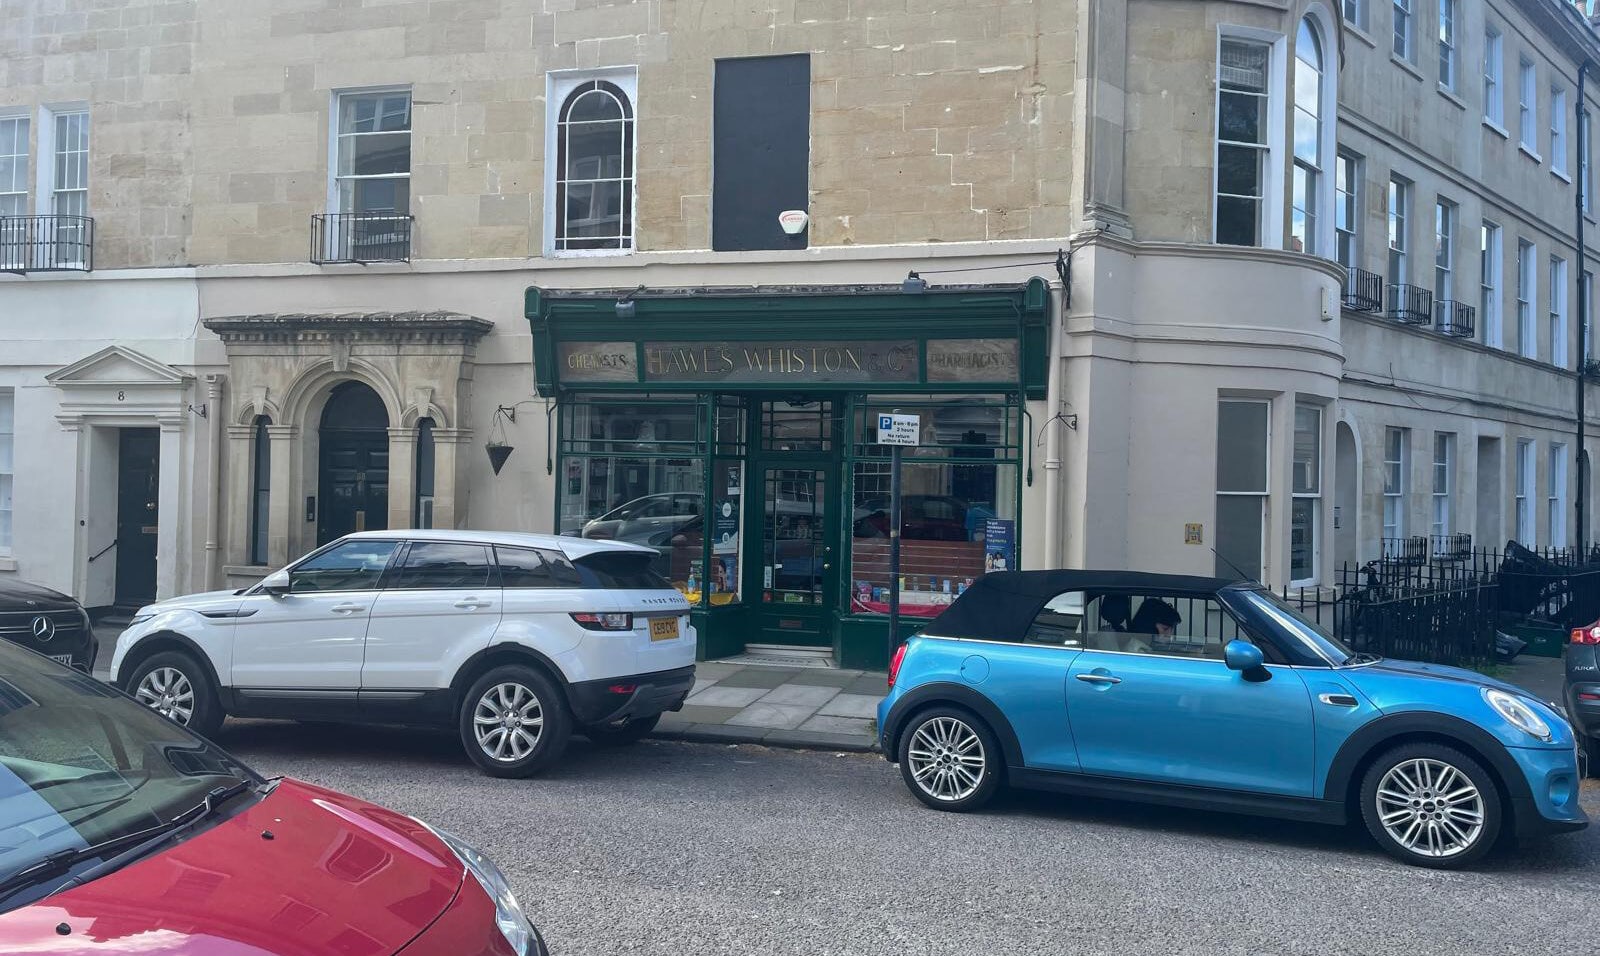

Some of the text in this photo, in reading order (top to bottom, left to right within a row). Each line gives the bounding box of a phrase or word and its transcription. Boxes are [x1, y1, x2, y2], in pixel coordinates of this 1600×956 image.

[743, 347, 862, 373] WHISTON
[118, 391, 124, 401] 8
[882, 418, 890, 428] P
